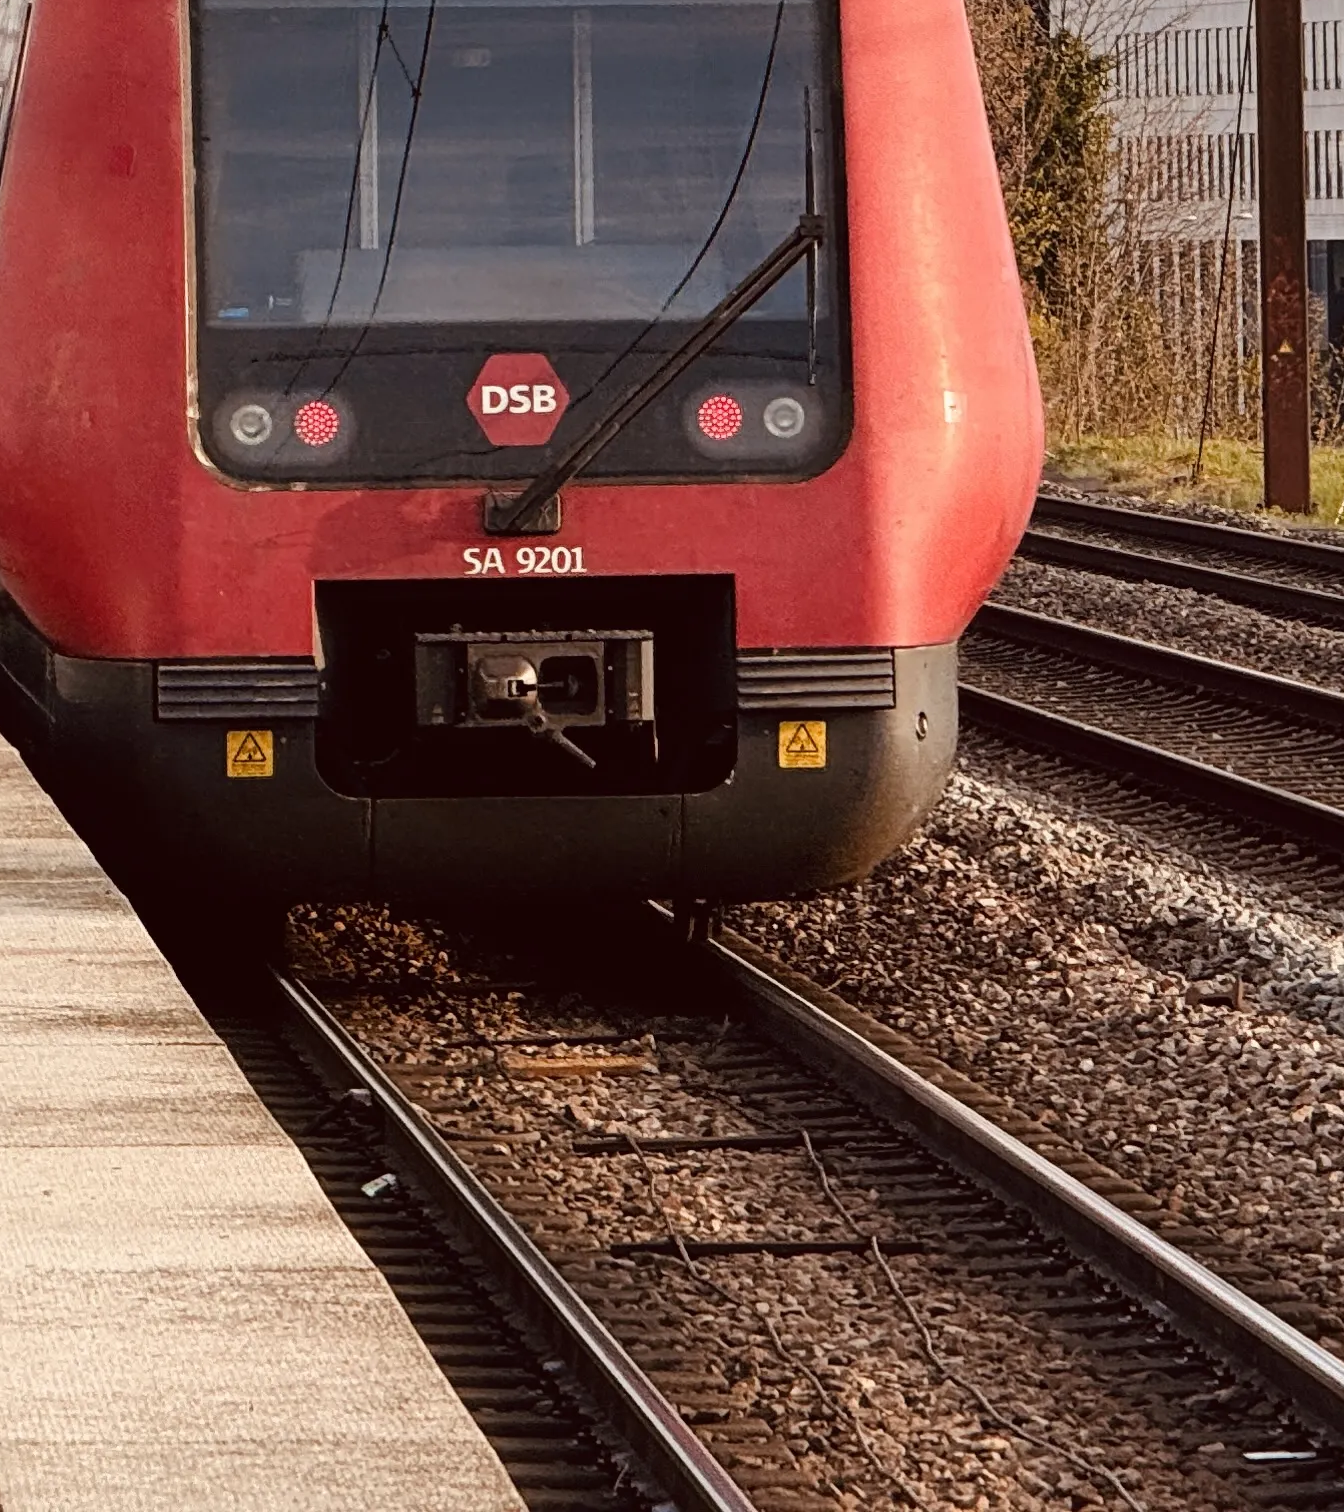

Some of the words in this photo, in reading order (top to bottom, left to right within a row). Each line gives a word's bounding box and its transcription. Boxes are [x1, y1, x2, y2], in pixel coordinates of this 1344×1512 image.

[482, 384, 556, 414] DSB
[463, 547, 506, 575] SA
[516, 546, 588, 574] 9201
